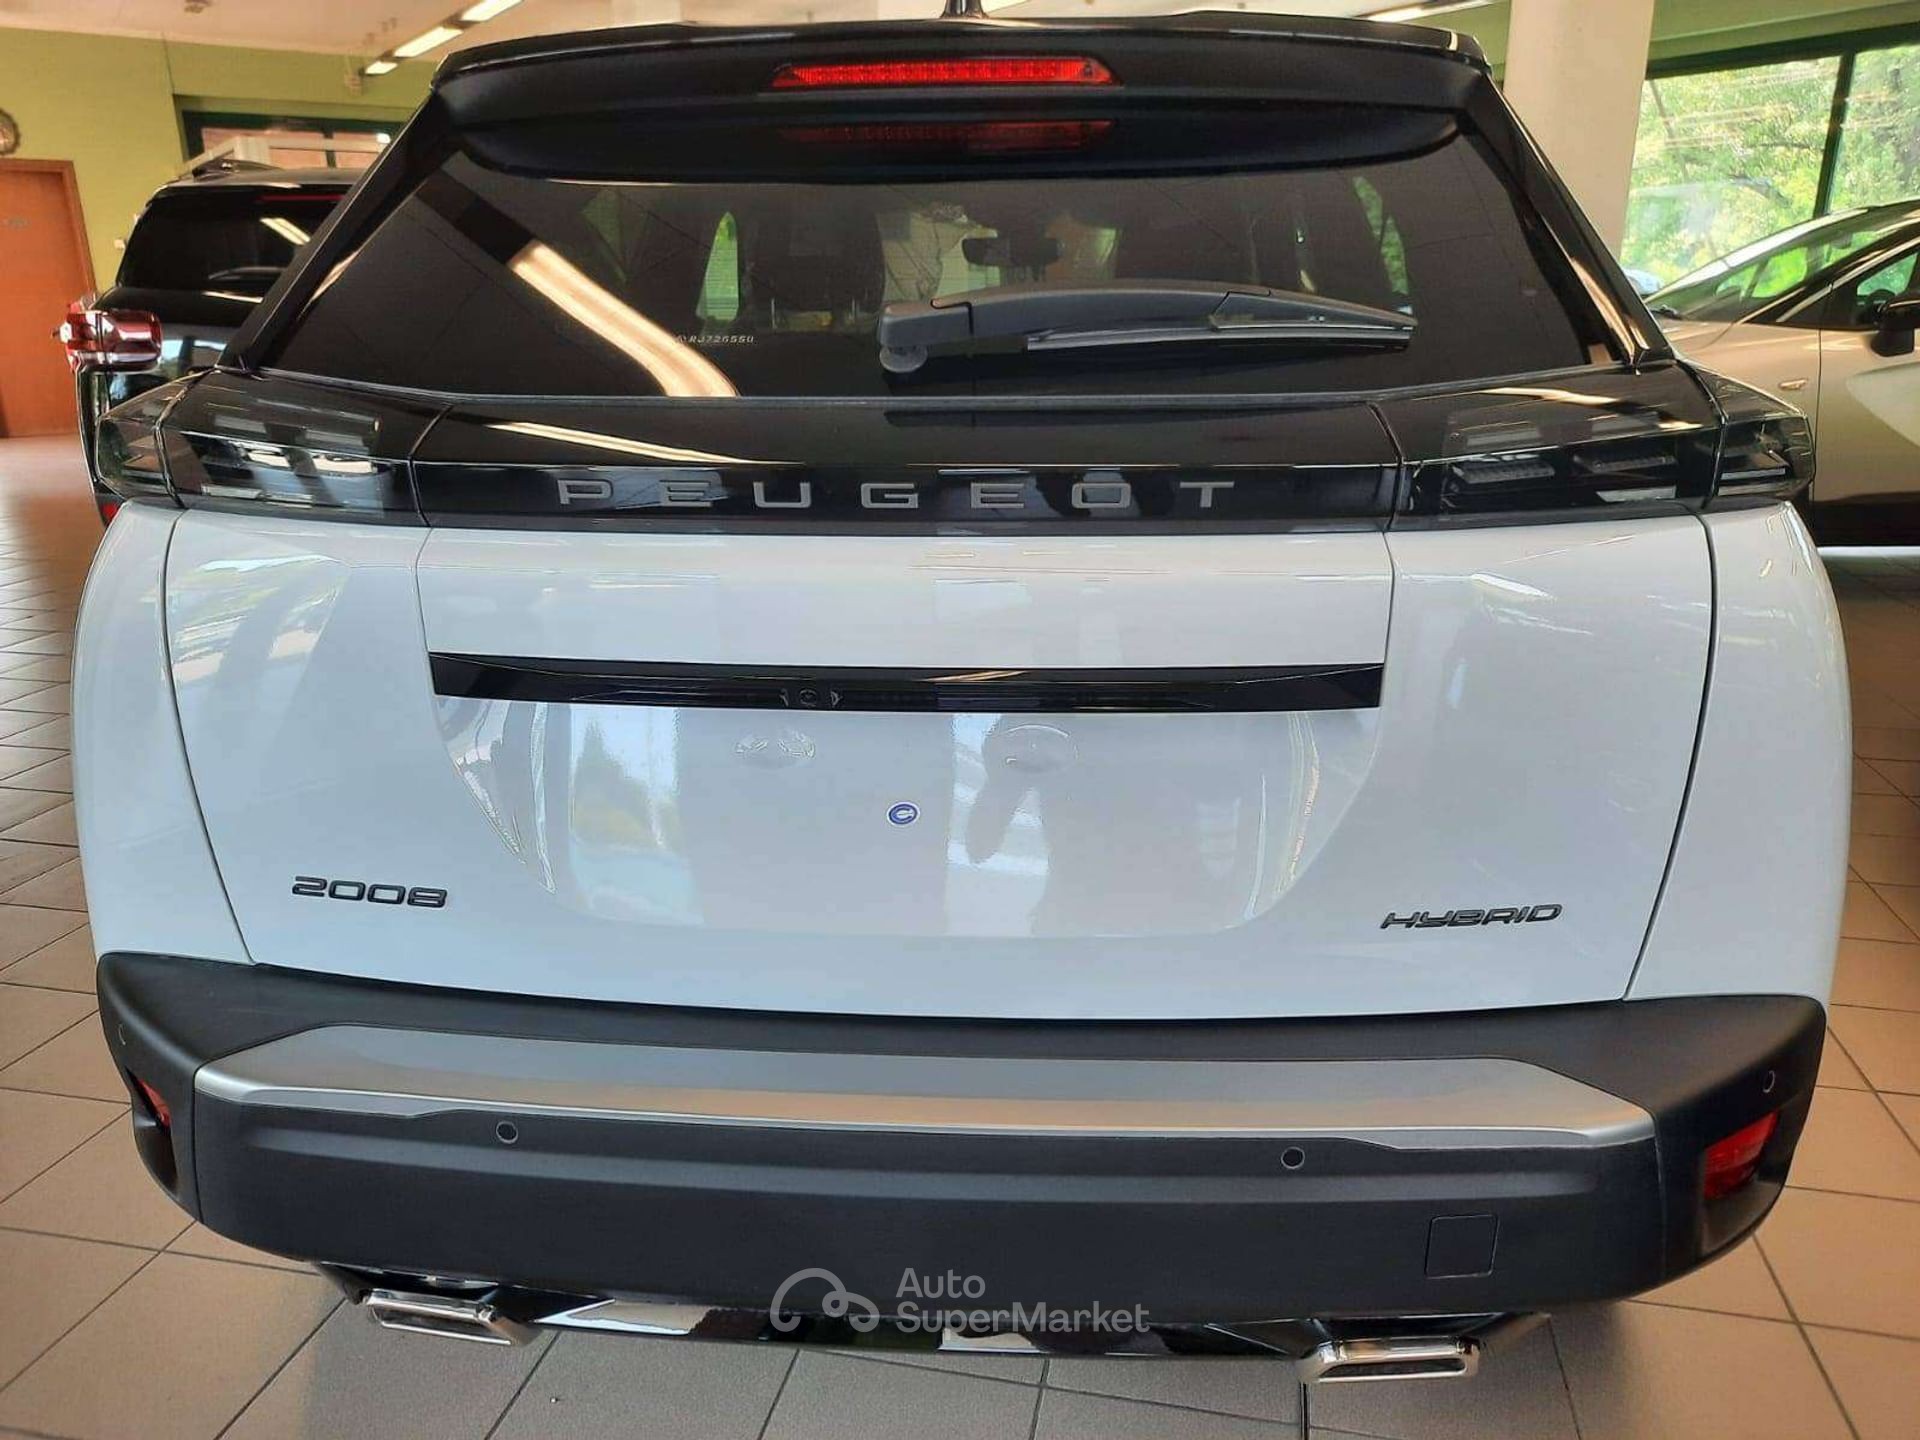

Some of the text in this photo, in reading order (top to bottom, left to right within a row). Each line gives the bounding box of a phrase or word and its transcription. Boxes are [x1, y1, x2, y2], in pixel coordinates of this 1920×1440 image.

[557, 479, 1235, 508] PEUGEOT
[291, 876, 448, 908] 2008
[1380, 904, 1562, 929] HYBRID
